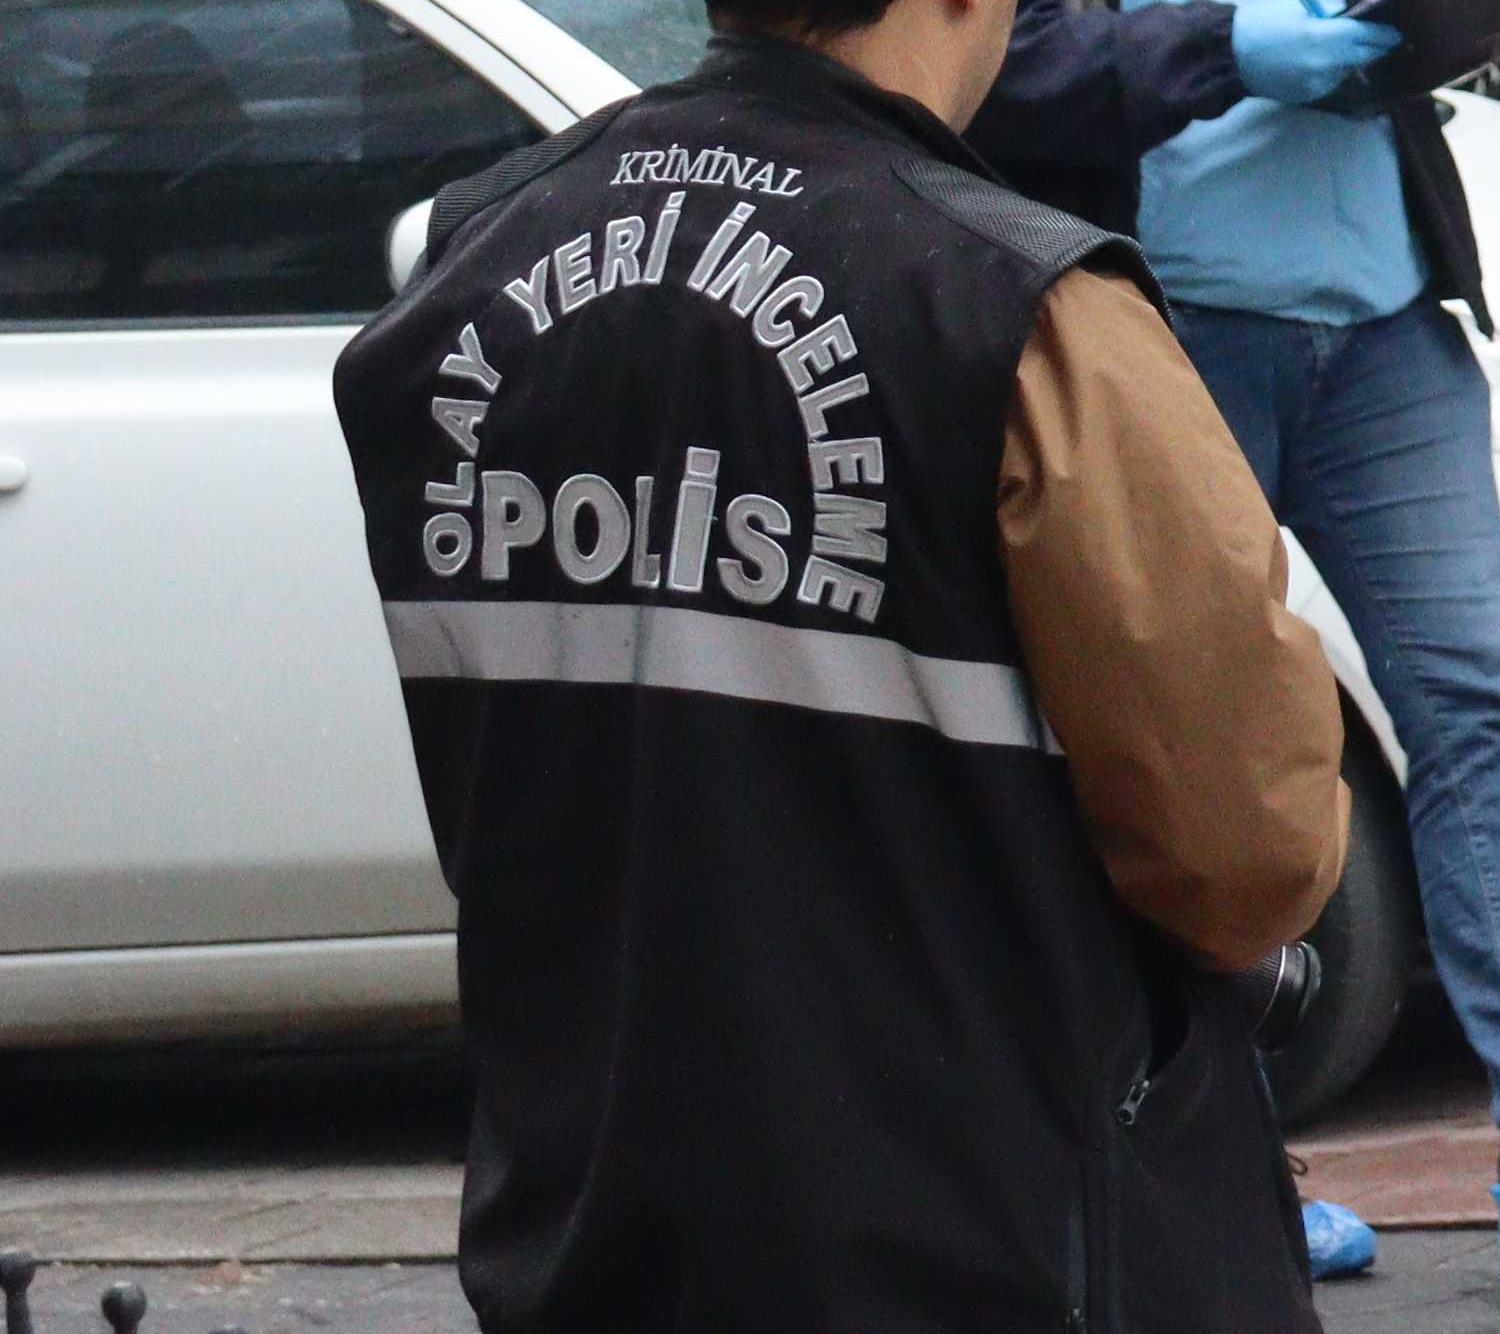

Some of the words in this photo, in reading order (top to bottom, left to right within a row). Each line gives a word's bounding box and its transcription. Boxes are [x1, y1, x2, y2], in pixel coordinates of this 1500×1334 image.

[610, 143, 804, 198] KRİMİNAL
[423, 322, 503, 577] OLAY
[504, 190, 686, 336] YERİ
[687, 202, 887, 624] İNCELEME
[480, 446, 791, 605] POLİS
